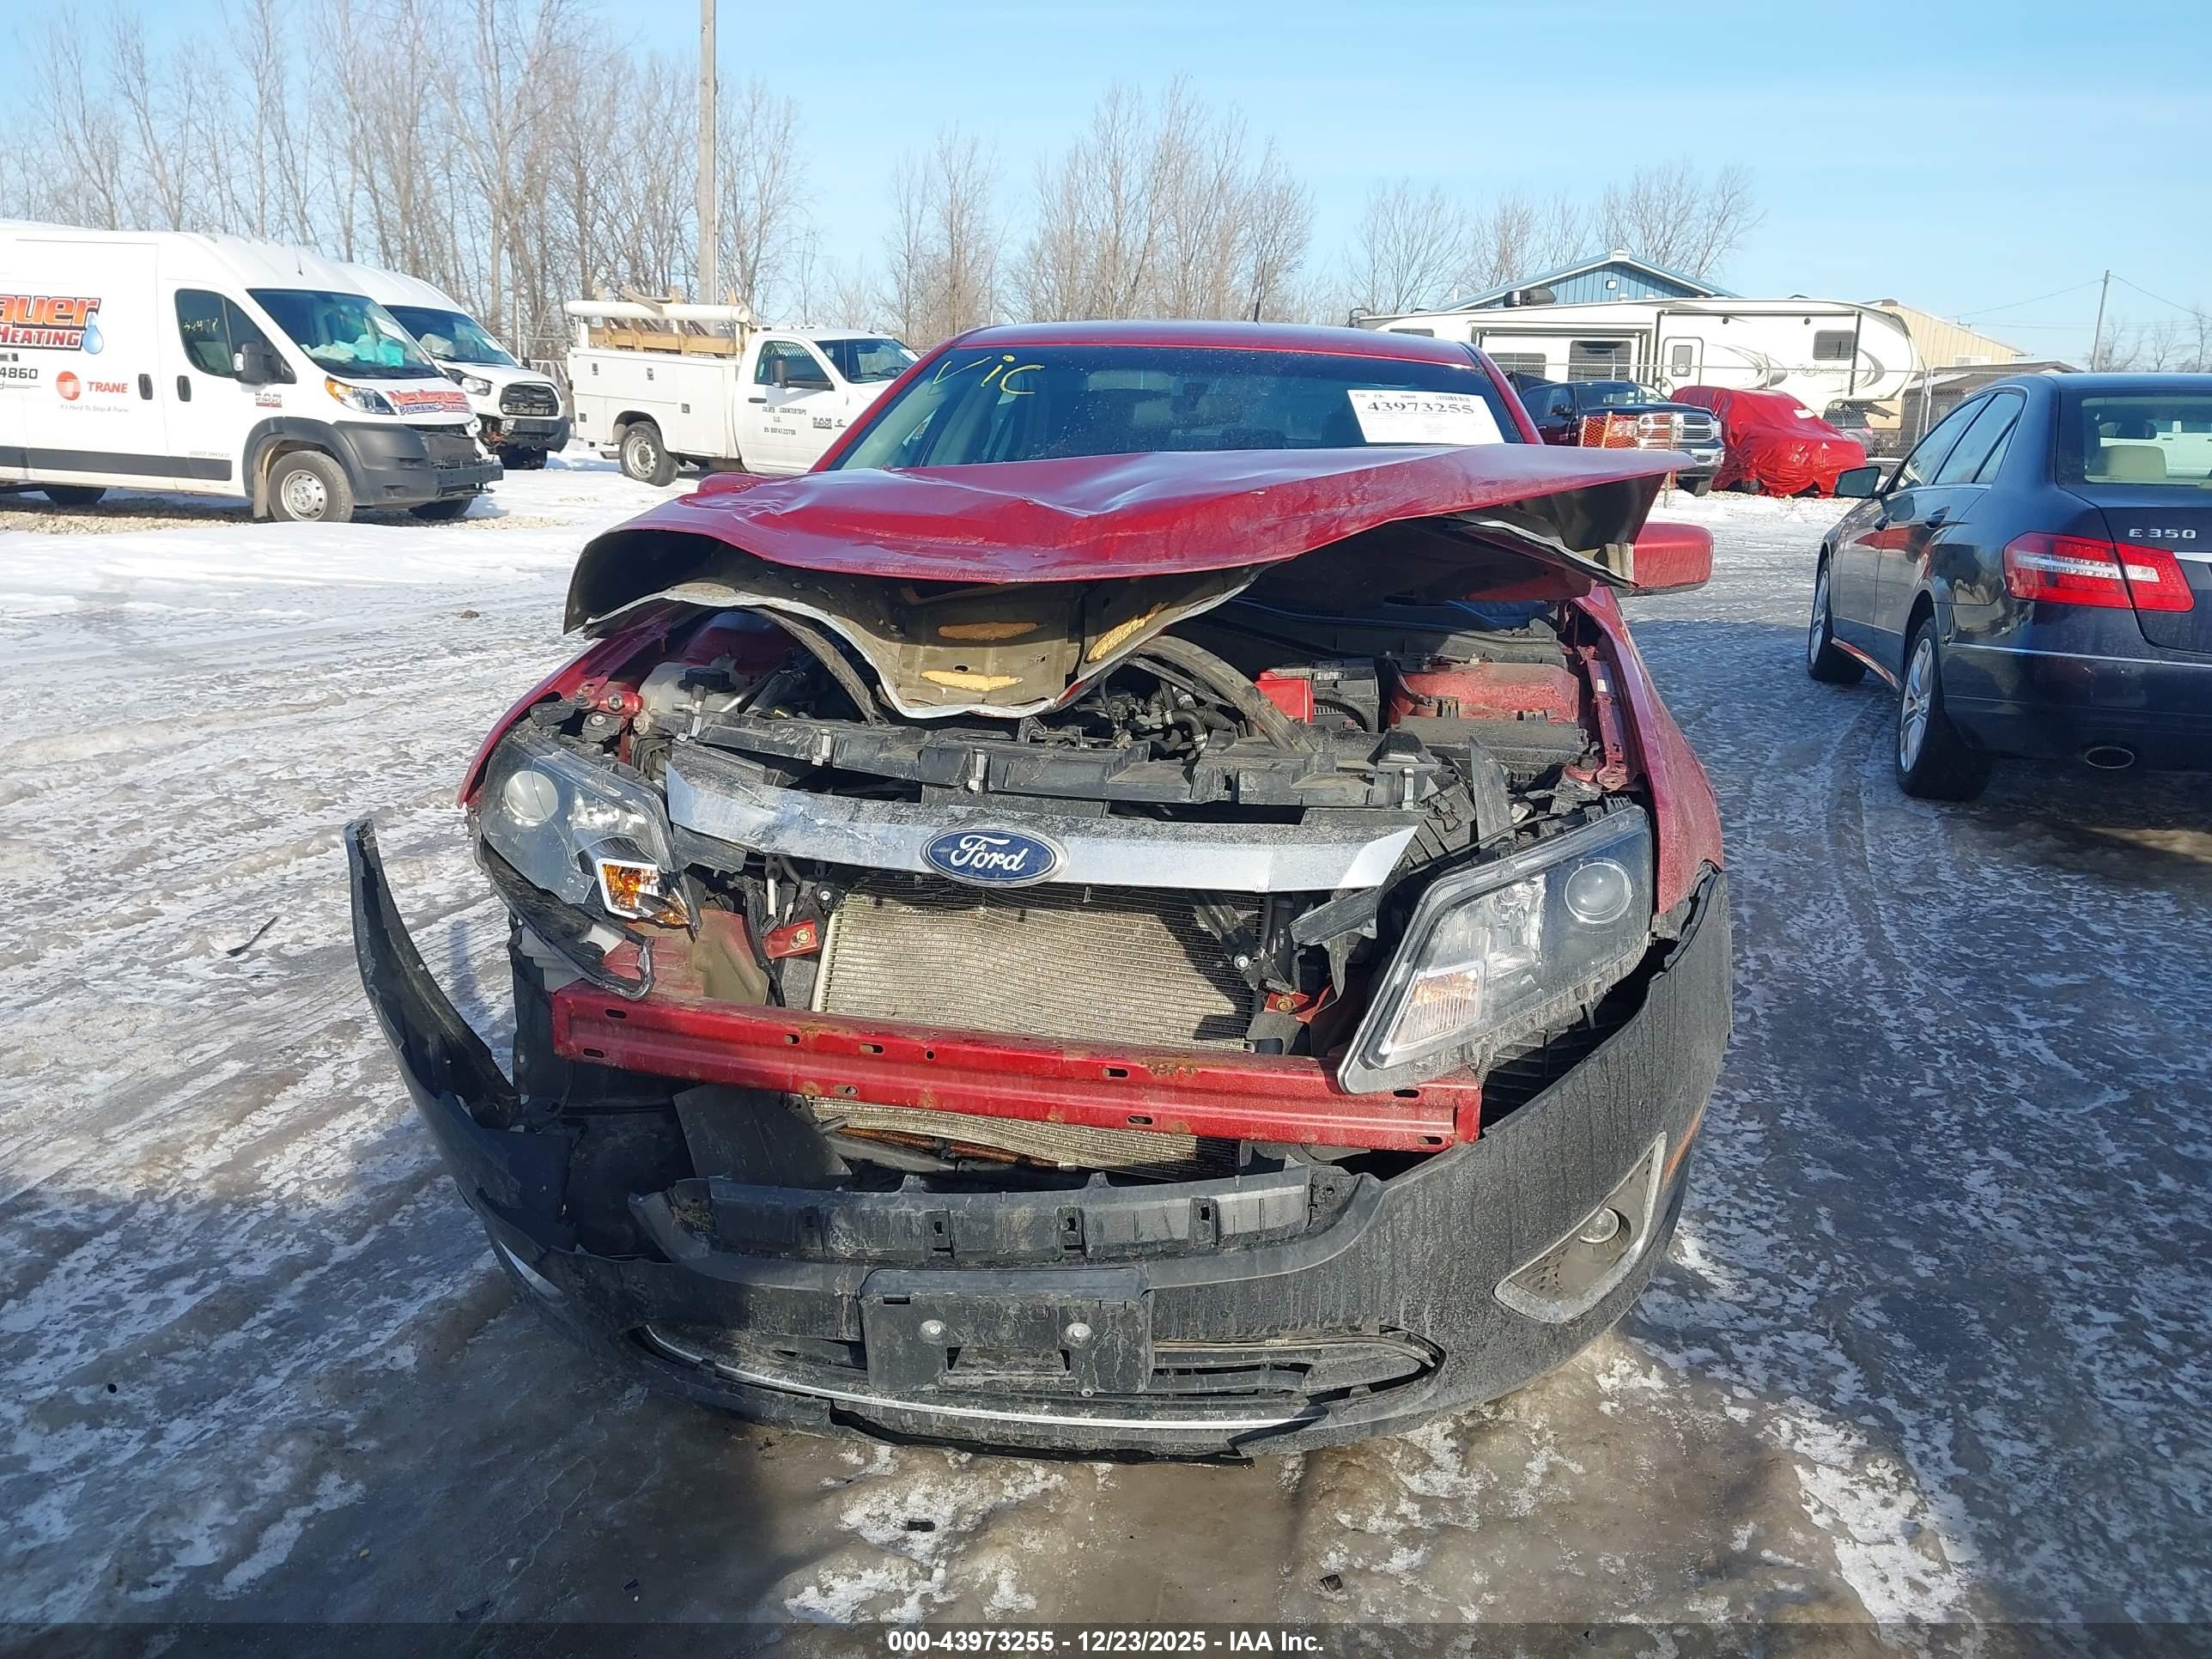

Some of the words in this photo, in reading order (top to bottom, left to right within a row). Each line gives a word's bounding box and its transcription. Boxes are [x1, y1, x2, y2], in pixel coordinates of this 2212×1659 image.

[87, 381, 128, 393] TRANE
[1367, 402, 1474, 415] 43973255
[950, 835, 1030, 872] Ford
